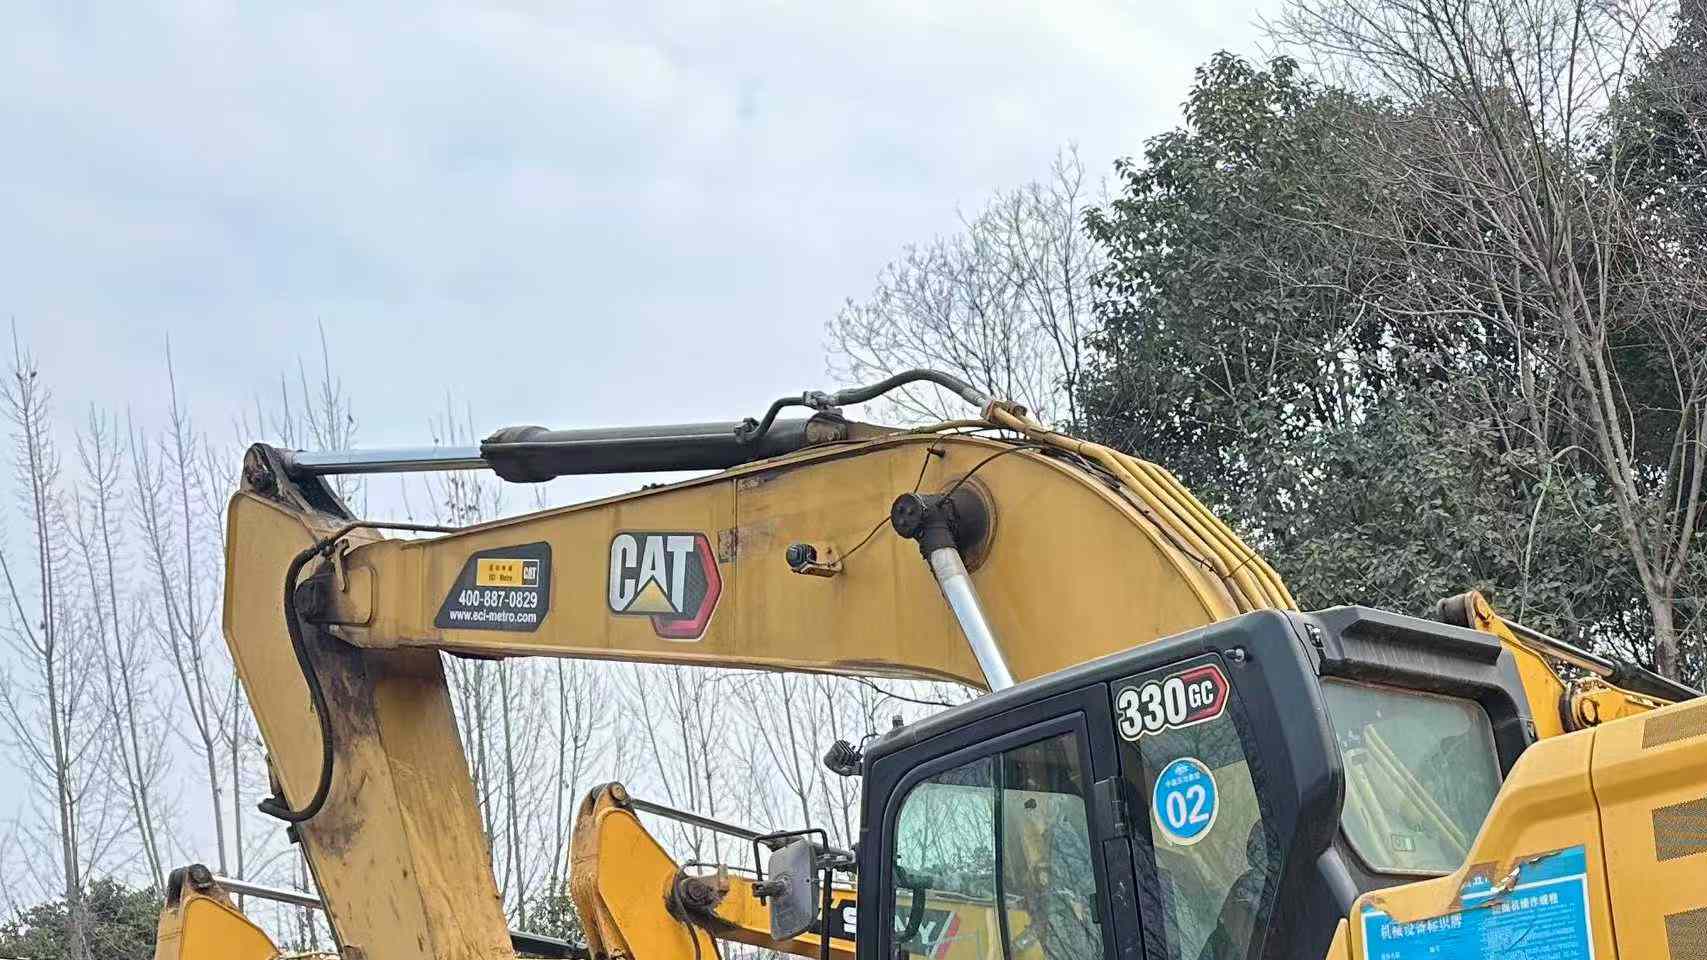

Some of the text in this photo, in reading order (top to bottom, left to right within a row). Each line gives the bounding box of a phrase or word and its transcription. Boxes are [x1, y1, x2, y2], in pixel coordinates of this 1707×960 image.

[523, 566, 537, 580] CAT
[610, 534, 694, 613] CAT
[458, 589, 538, 609] 400-887-0829
[449, 609, 537, 623] www.eci-metro.com
[1118, 677, 1214, 737] 330 GC
[1166, 784, 1210, 829] 02
